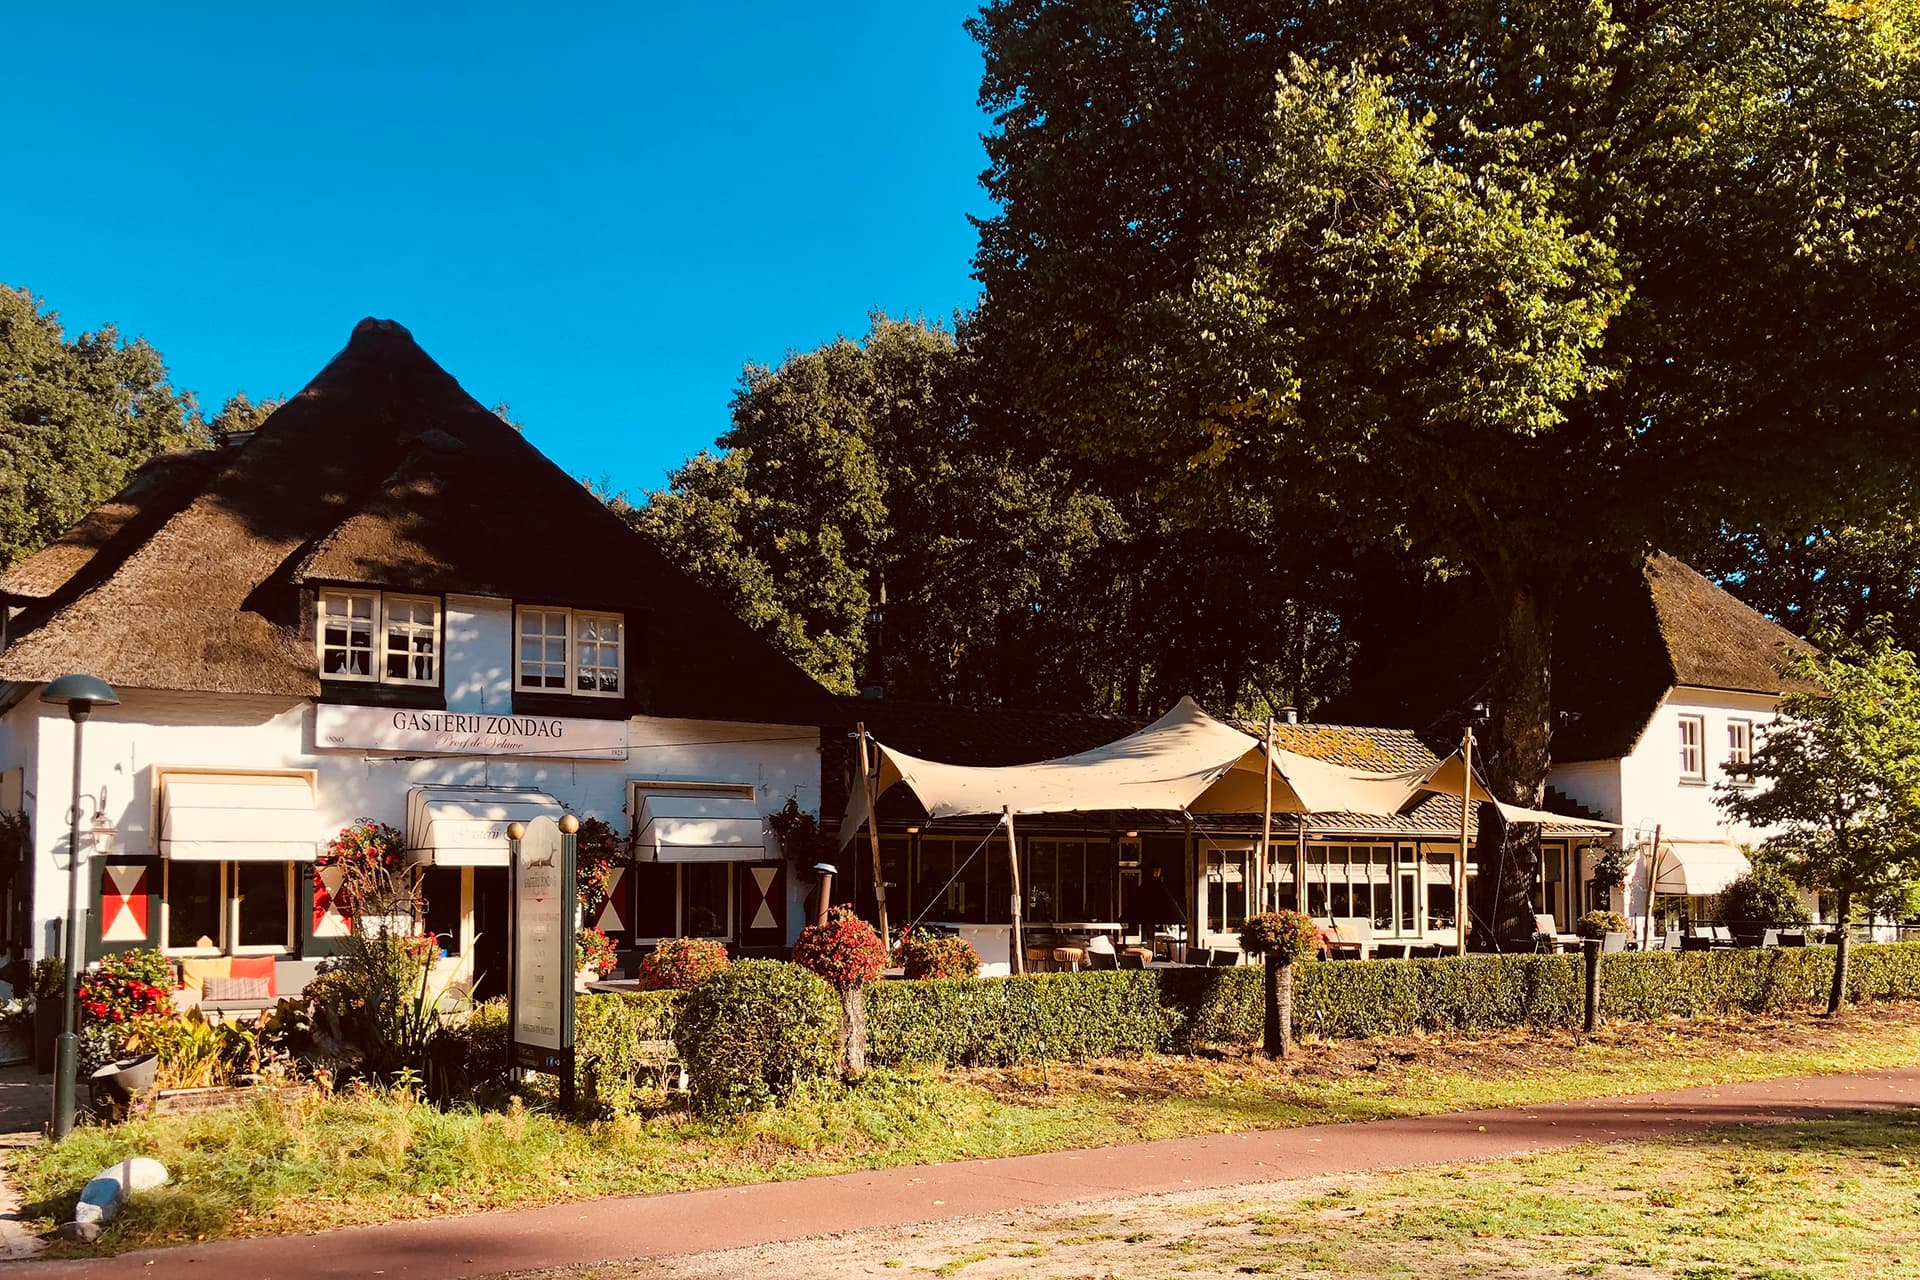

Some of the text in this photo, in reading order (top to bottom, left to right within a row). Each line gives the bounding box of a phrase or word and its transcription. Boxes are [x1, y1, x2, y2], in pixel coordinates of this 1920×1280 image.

[393, 712, 563, 738] GASTERIJ ZONDAG
[470, 737, 482, 748] de
[484, 736, 524, 749] Veluwe
